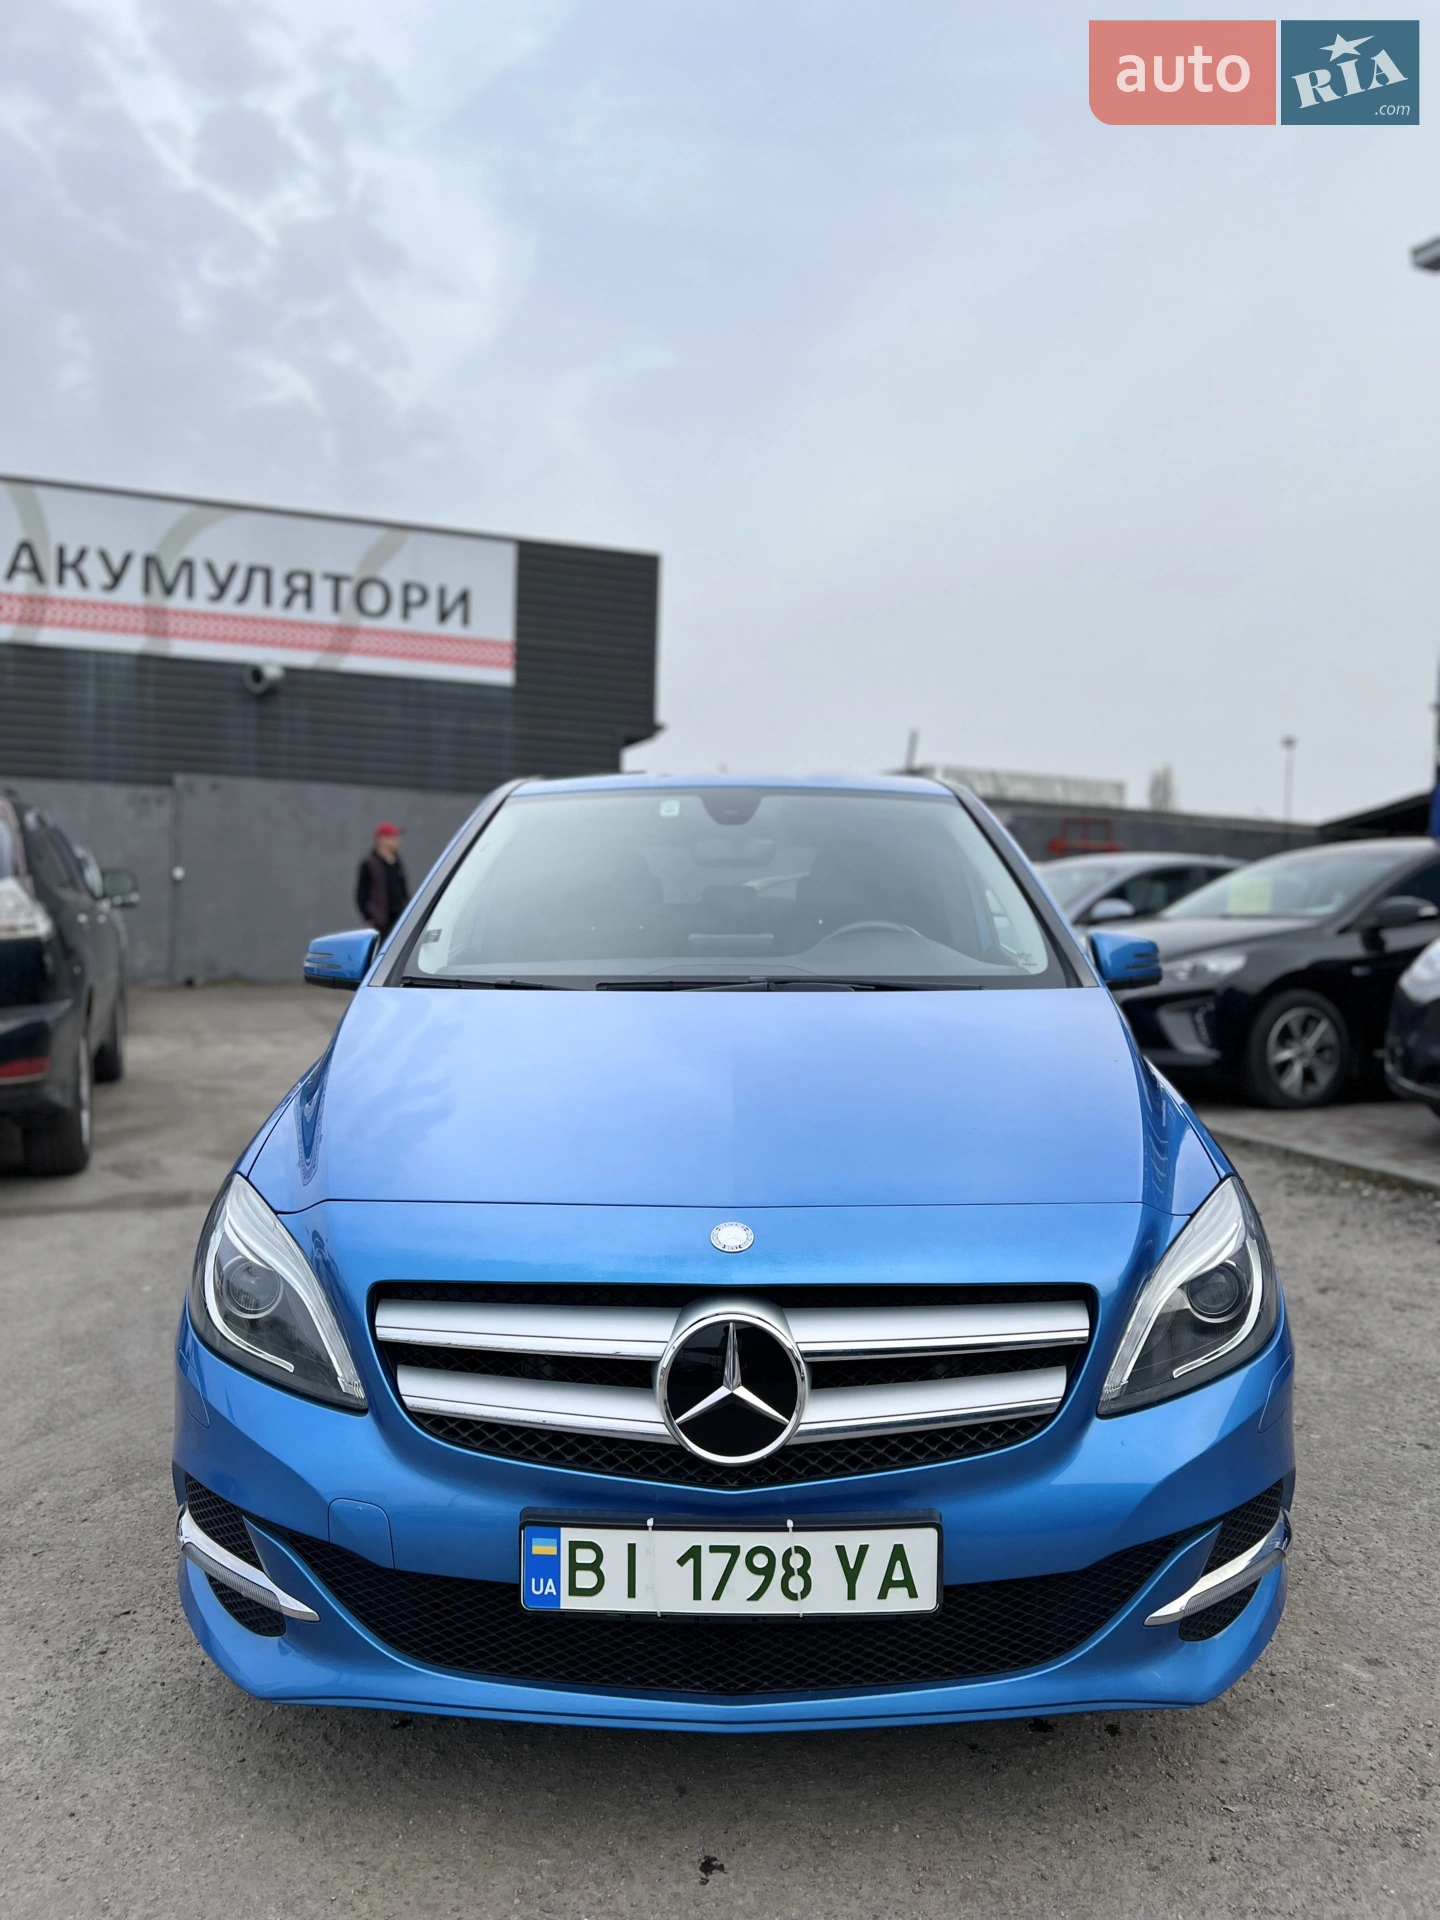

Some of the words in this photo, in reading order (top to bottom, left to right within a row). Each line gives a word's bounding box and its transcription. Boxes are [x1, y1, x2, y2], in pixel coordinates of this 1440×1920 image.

[5, 540, 472, 628] АКУМУЛЯТОРИ
[531, 1577, 558, 1597] UA
[676, 1544, 813, 1602] 1798
[834, 1543, 919, 1601] YA
